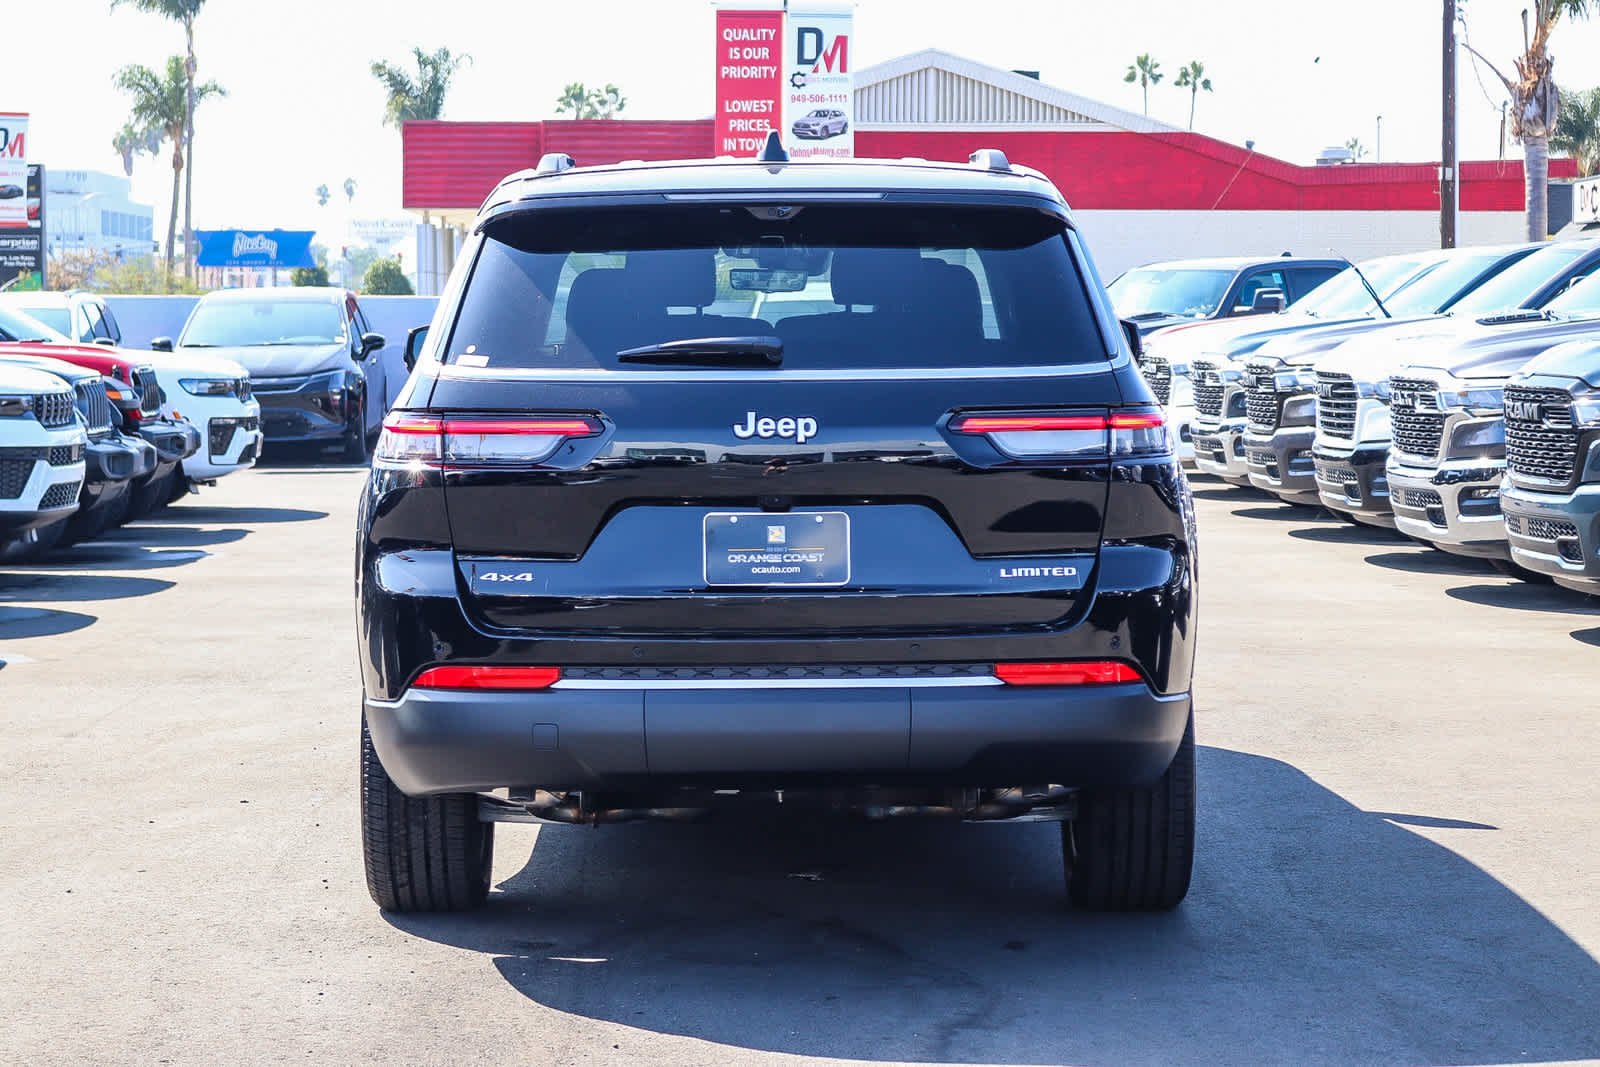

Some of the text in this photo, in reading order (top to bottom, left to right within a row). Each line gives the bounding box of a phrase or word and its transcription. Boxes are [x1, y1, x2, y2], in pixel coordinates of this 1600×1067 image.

[723, 28, 776, 41] QUALITY
[729, 47, 770, 59] IS OUR
[797, 27, 849, 73] DM
[721, 66, 777, 79] PRIORITY
[725, 100, 774, 113] LOWEST
[729, 119, 770, 131] PRICES
[724, 138, 737, 151] IN
[1504, 401, 1539, 421] RAM
[733, 411, 818, 444] Jeep
[727, 553, 825, 563] ORANGE COAST
[751, 565, 801, 574] ocauto.com
[1000, 567, 1077, 578] LIMITED
[479, 572, 533, 582] 4x4
